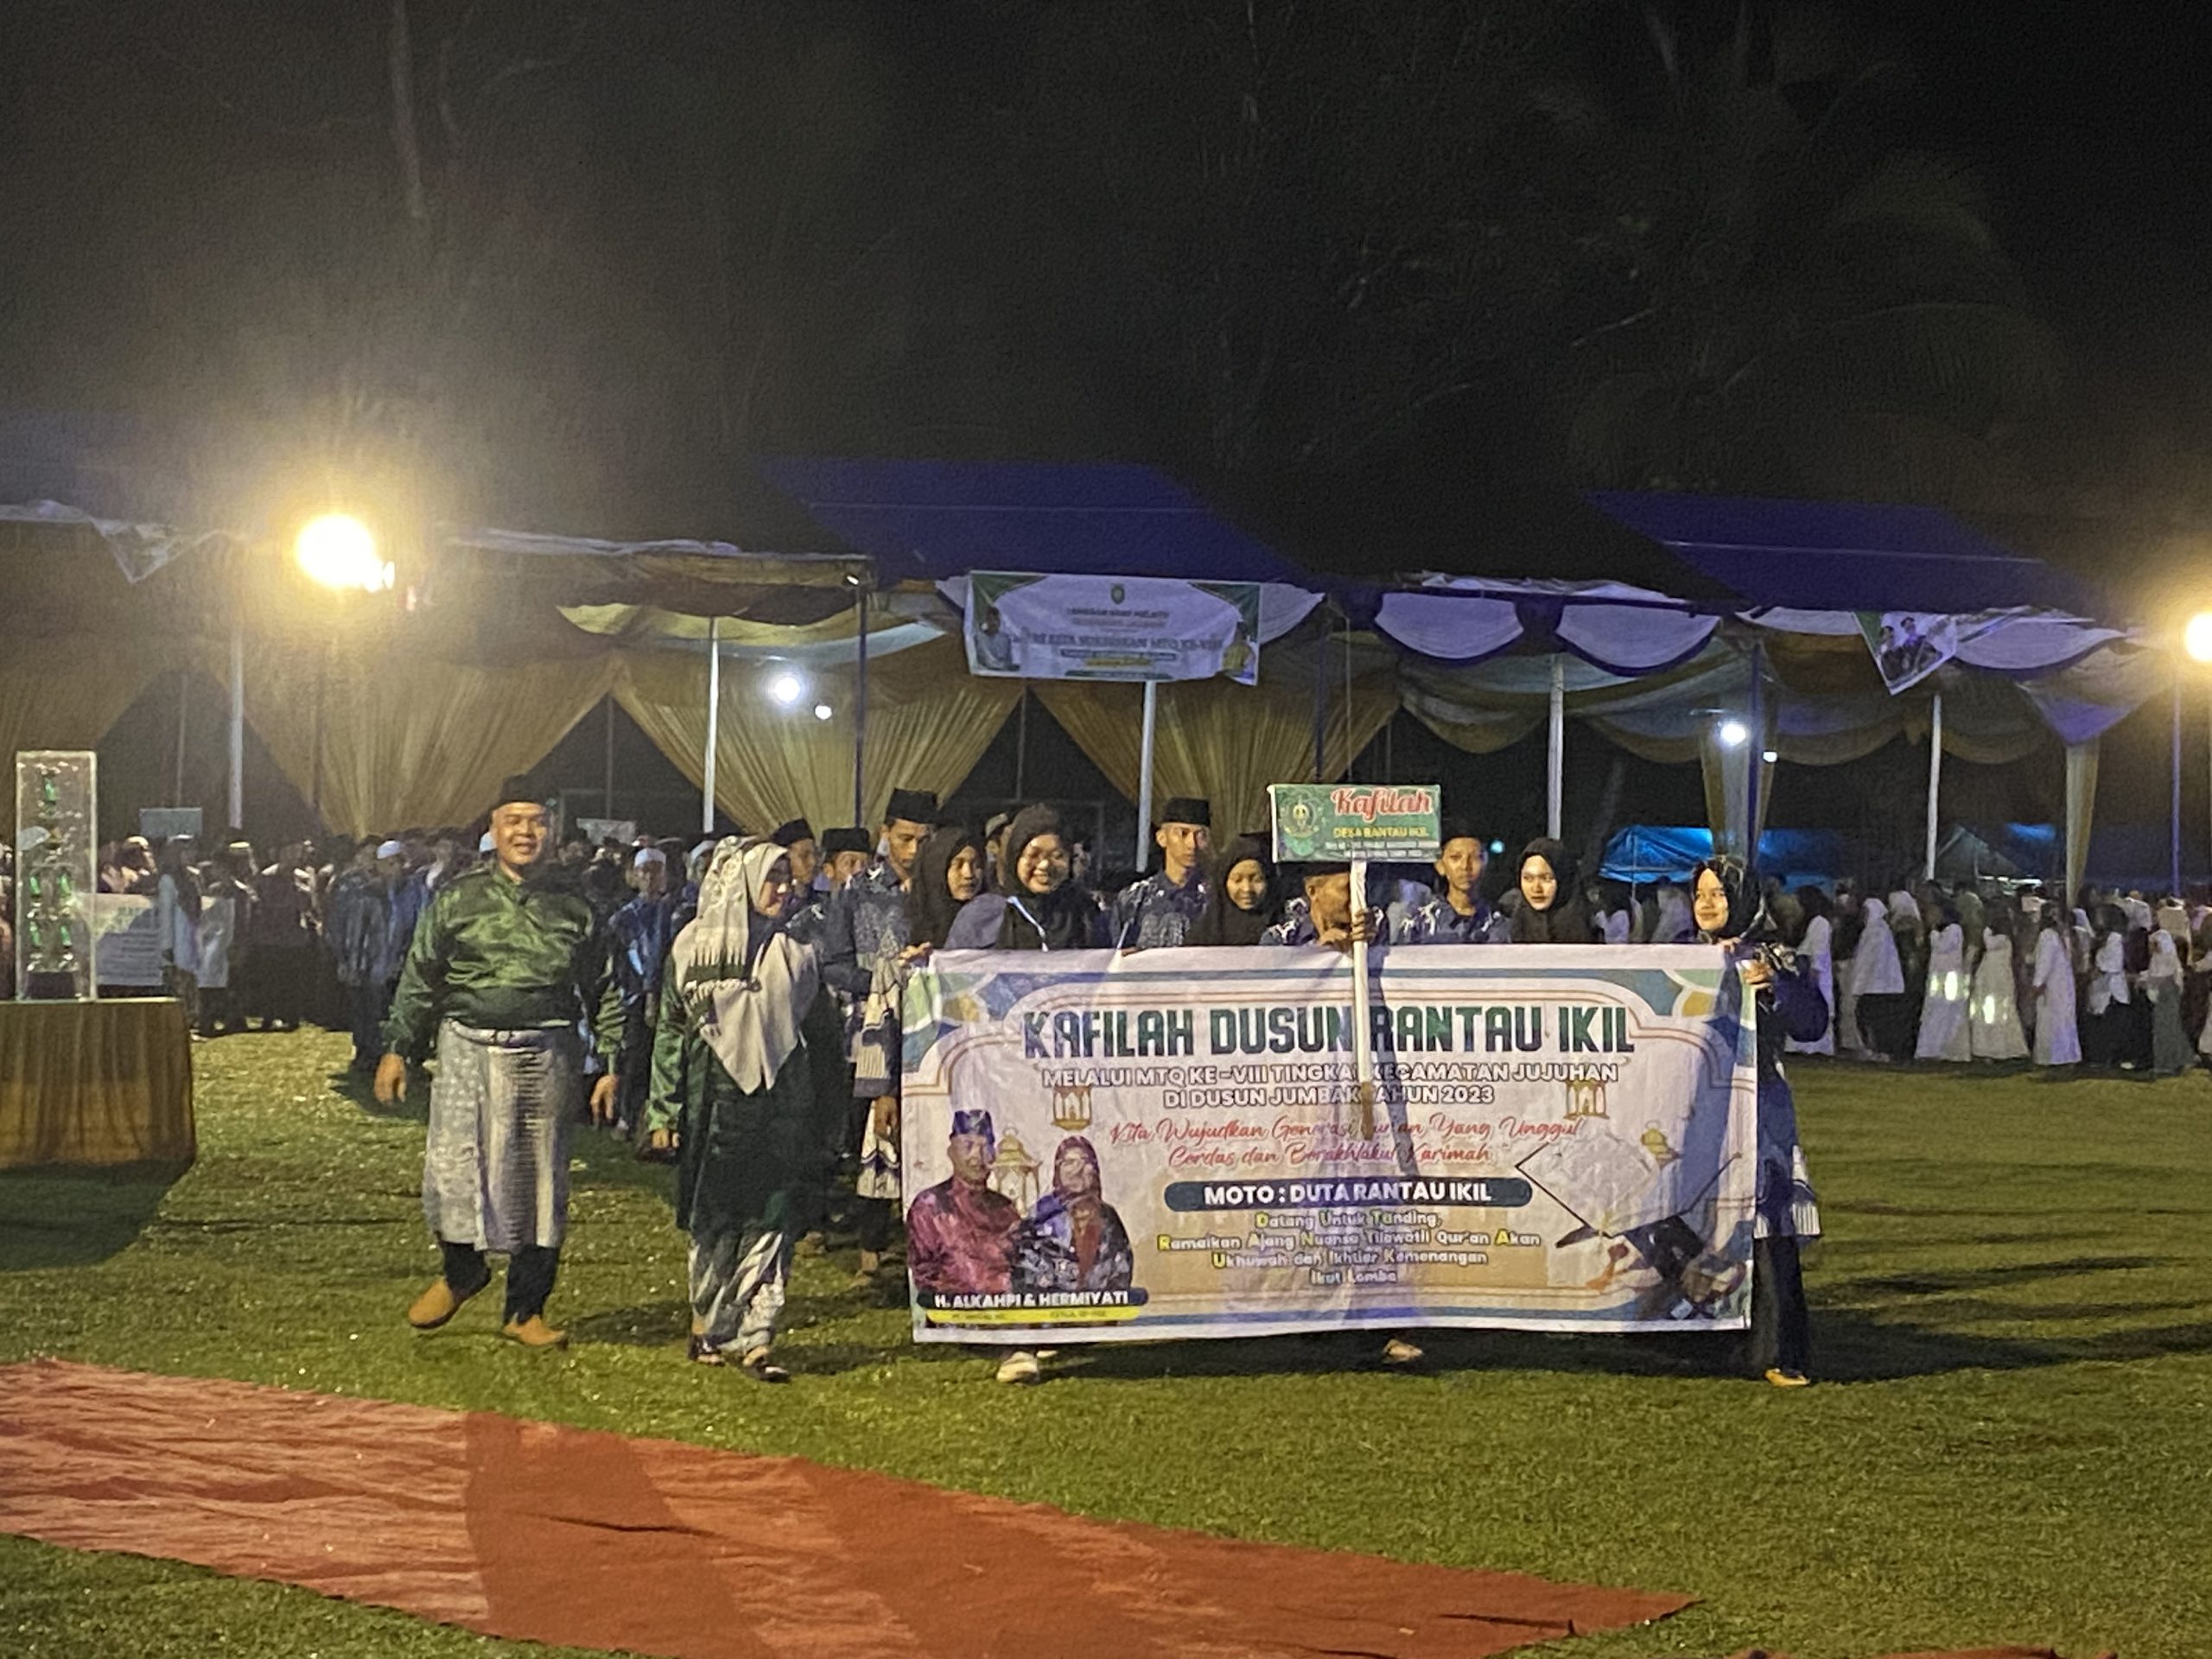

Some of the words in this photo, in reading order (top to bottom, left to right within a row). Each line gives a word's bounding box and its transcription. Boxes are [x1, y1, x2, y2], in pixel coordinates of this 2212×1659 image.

[1331, 788, 1433, 822] Kafilah
[1333, 826, 1363, 838] DESA
[1363, 826, 1408, 838] RANTAU
[1024, 1008, 1194, 1058] KAFILAH
[1211, 1007, 1353, 1054] DUSUN
[1370, 1006, 1542, 1052] RANTAU
[1559, 1006, 1635, 1052] IKIL
[1043, 1068, 1133, 1088] MELALUI
[1136, 1066, 1186, 1088] MTQ
[1271, 1063, 1359, 1082] TINGKA
[1513, 1063, 1619, 1083] JUJUHAN
[1164, 1089, 1189, 1109] DI
[1191, 1087, 1266, 1109] DUSUN
[1269, 1085, 1362, 1106] JUMBAK
[1372, 1084, 1439, 1105] AHUN
[1440, 1084, 1495, 1104] 2023
[1109, 1122, 1153, 1144] Kita
[1156, 1117, 1268, 1145] Wujudkan
[1428, 1111, 1492, 1141] Yang
[1498, 1116, 1583, 1141] Unggul
[1168, 1145, 1235, 1166] Cerdas
[1241, 1147, 1281, 1165] dan
[1204, 1186, 1274, 1205] MOTO
[1290, 1184, 1351, 1204] DUTA
[1353, 1181, 1446, 1202] RANTAU
[1449, 1181, 1492, 1201] IKIL
[1255, 1211, 1315, 1230] Datang
[1319, 1211, 1367, 1227] Untuk
[1157, 1233, 1242, 1251] Ramaikan
[1247, 1231, 1295, 1251] Ajang
[1435, 1230, 1491, 1246] Qur'an
[1494, 1228, 1541, 1247] Akan
[1293, 1255, 1323, 1268] dan
[1383, 1249, 1488, 1268] Kemenangan
[934, 1294, 950, 1308] H.
[1023, 1293, 1036, 1306] &
[1039, 1291, 1129, 1307] HERMIYATI
